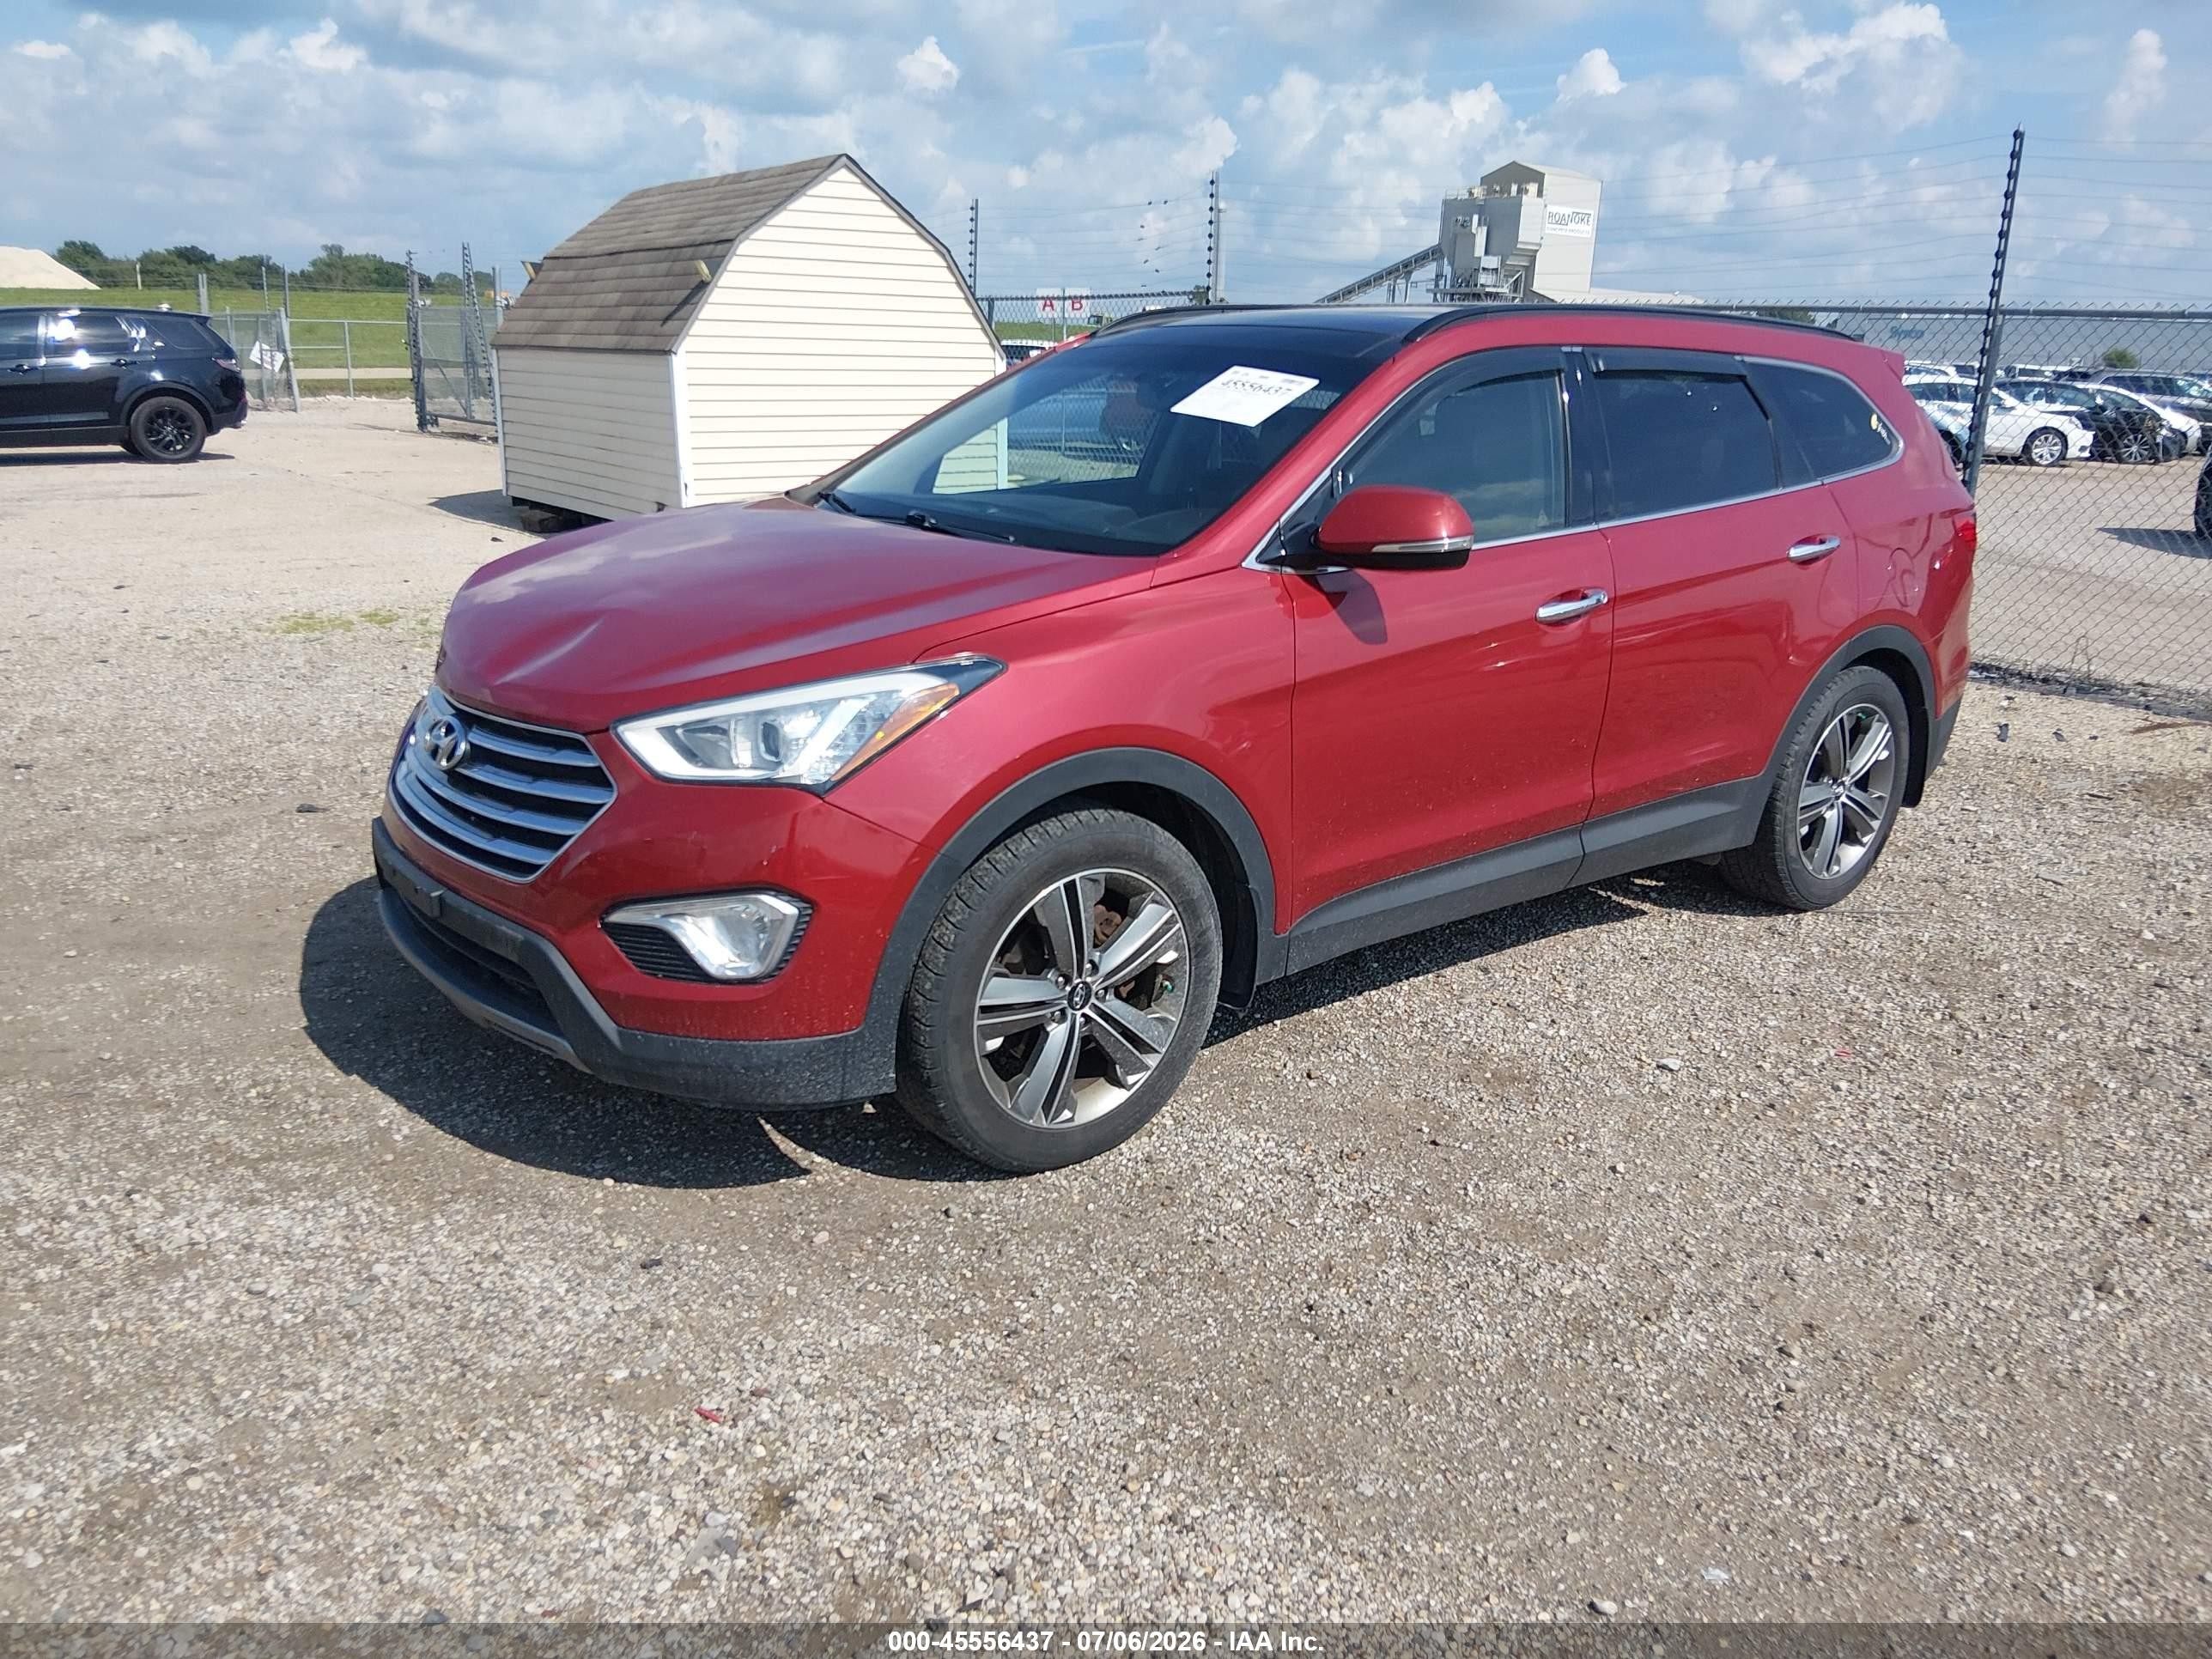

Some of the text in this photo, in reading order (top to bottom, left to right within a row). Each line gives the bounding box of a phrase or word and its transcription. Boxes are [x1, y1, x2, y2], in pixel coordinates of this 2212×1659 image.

[1547, 211, 1591, 226] ROANOKE
[1042, 296, 1054, 311] A
[1071, 296, 1083, 311] B
[1221, 379, 1292, 395] 45556437
